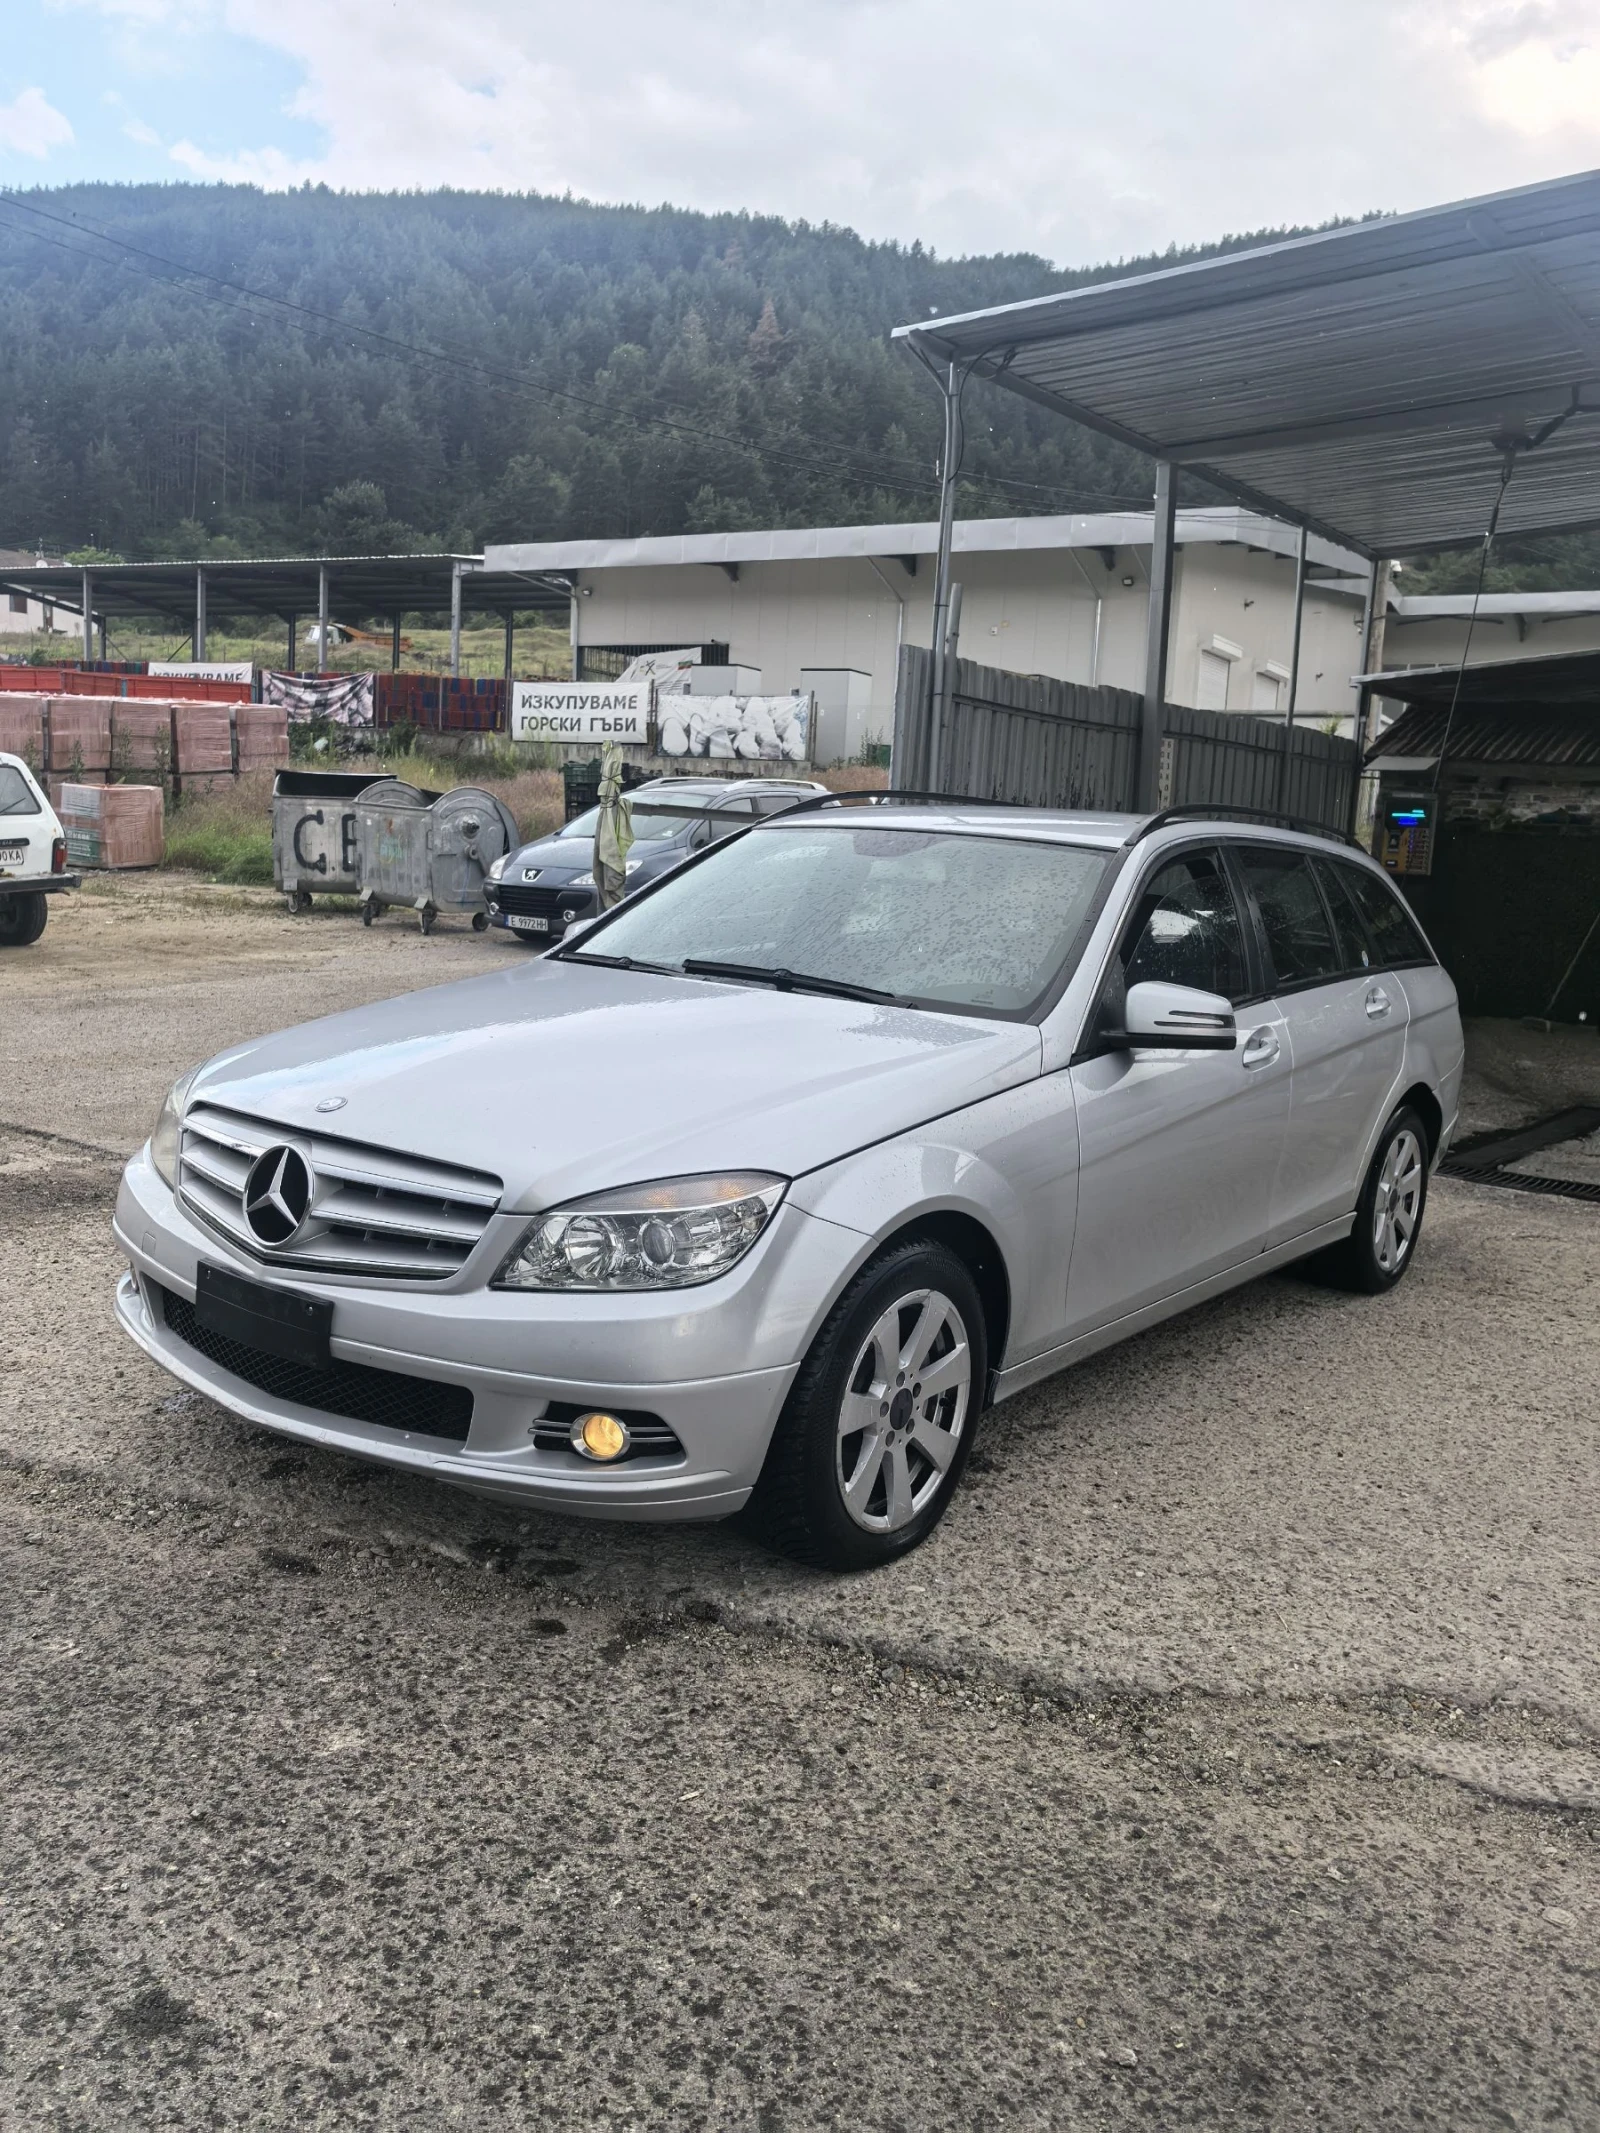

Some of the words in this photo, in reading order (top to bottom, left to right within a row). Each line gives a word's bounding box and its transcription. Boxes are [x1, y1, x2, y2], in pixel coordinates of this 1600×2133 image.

[521, 694, 638, 710] ИЗКУПУВАМЕ
[520, 715, 581, 732] ГОРСКИ
[589, 717, 637, 732] ГЪБИ
[0, 850, 22, 862] 0KA
